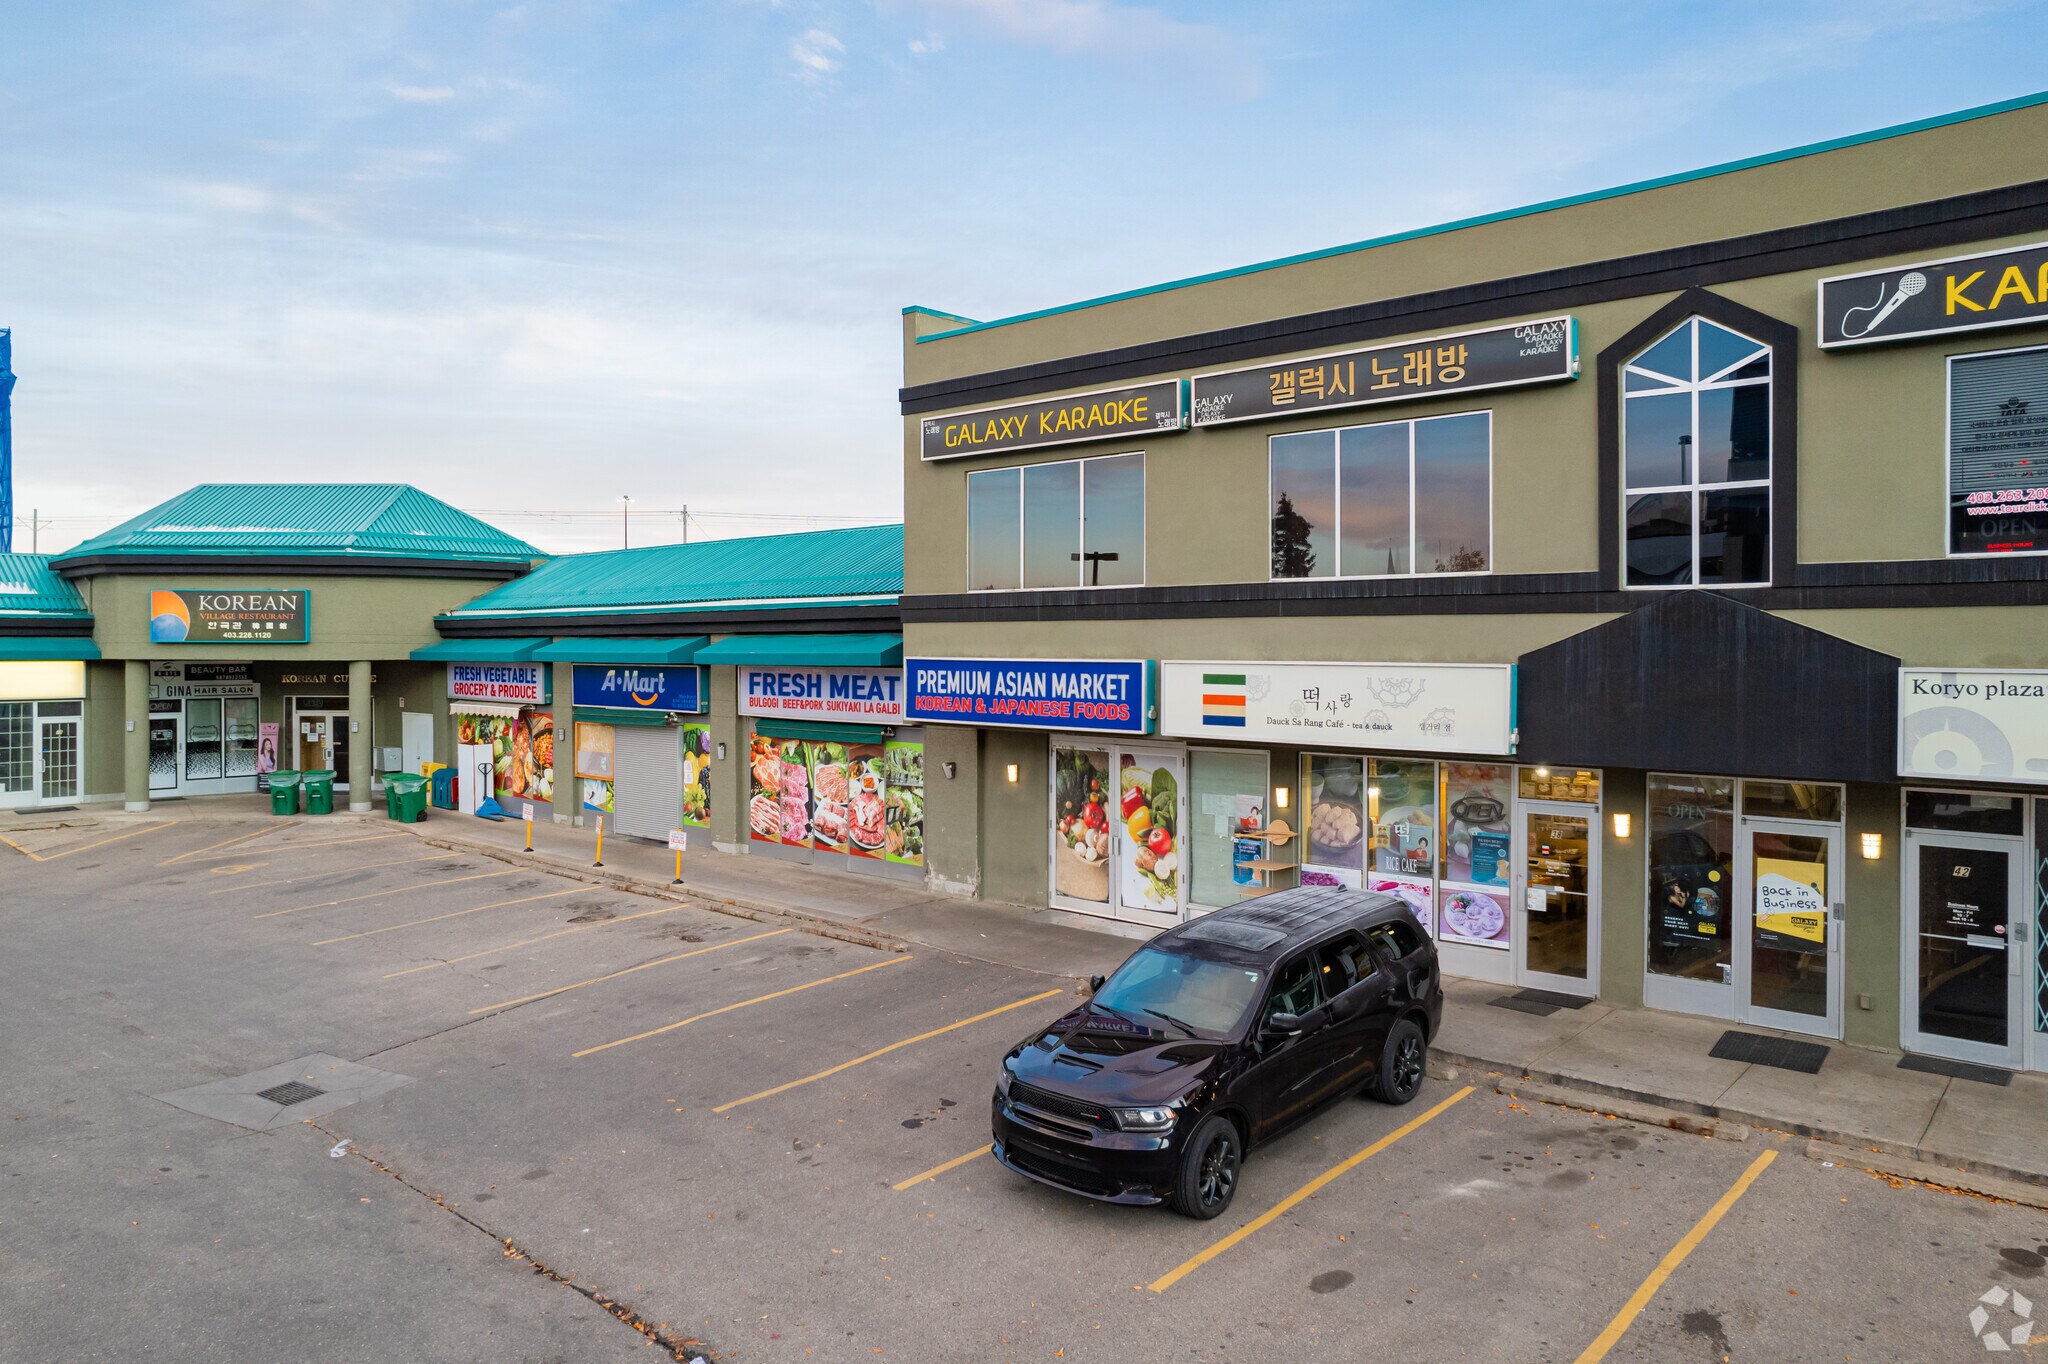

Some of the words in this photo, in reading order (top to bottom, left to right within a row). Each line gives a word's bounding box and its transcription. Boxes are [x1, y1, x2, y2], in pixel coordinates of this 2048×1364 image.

[1945, 261, 2048, 316] KA
[1514, 321, 1567, 338] GALAXY
[1525, 331, 1564, 344] KARAOKE
[1520, 344, 1558, 357] KARAOKE
[1536, 338, 1564, 348] GALAXY
[1269, 360, 1355, 406] 갤럭시
[1370, 343, 1469, 391] 노래방
[1194, 394, 1234, 409] GALAXY
[1197, 404, 1225, 414] KARAOKE
[945, 414, 1029, 448] GALAXY
[1039, 396, 1148, 435] KARAOKE
[1198, 414, 1226, 423] KARAOKE
[1981, 518, 2037, 538] OPEN
[199, 595, 297, 611] KOREAN
[191, 666, 227, 674] BEAUTY
[454, 666, 481, 681] FRESH
[483, 667, 537, 684] VEGETABLE
[282, 675, 327, 683] KOREAN
[749, 672, 821, 698] FRESH
[830, 674, 901, 701] MEAT
[916, 669, 990, 695] PREMIUM
[994, 671, 1046, 698] ASIAN
[1051, 673, 1130, 701] MARKET
[166, 685, 192, 697] GINA
[454, 682, 489, 697] GROCERY
[490, 684, 496, 697] &
[498, 684, 537, 699] PRODUCE
[1912, 678, 1979, 700] Koryo
[1984, 680, 2045, 701] plaza
[749, 697, 778, 709] BULGOGI
[782, 698, 824, 711] BEEF&PORK
[826, 700, 861, 713] SUKIYAKI
[863, 702, 875, 713] LA
[875, 703, 900, 715] GALBI
[915, 695, 972, 713] KOREAN
[975, 697, 987, 713] &
[989, 698, 1071, 718] JAPANESE
[1073, 701, 1130, 721] FOODS
[1266, 717, 1290, 726] Dauck
[1292, 718, 1302, 726] Sa
[1304, 719, 1323, 728] Rang
[1325, 719, 1344, 728] Café
[1372, 722, 1393, 730] dauck
[1668, 803, 1707, 820] OPEN
[1393, 822, 1410, 843] 떡
[1551, 830, 1562, 839] 38
[1385, 856, 1400, 871] RICE
[1401, 857, 1418, 873] CAKE
[1954, 867, 1970, 877] 42
[1762, 885, 1792, 897] Back
[1796, 887, 1809, 897] in
[1763, 897, 1817, 910] Business
[1791, 917, 1818, 926] GALAXY
